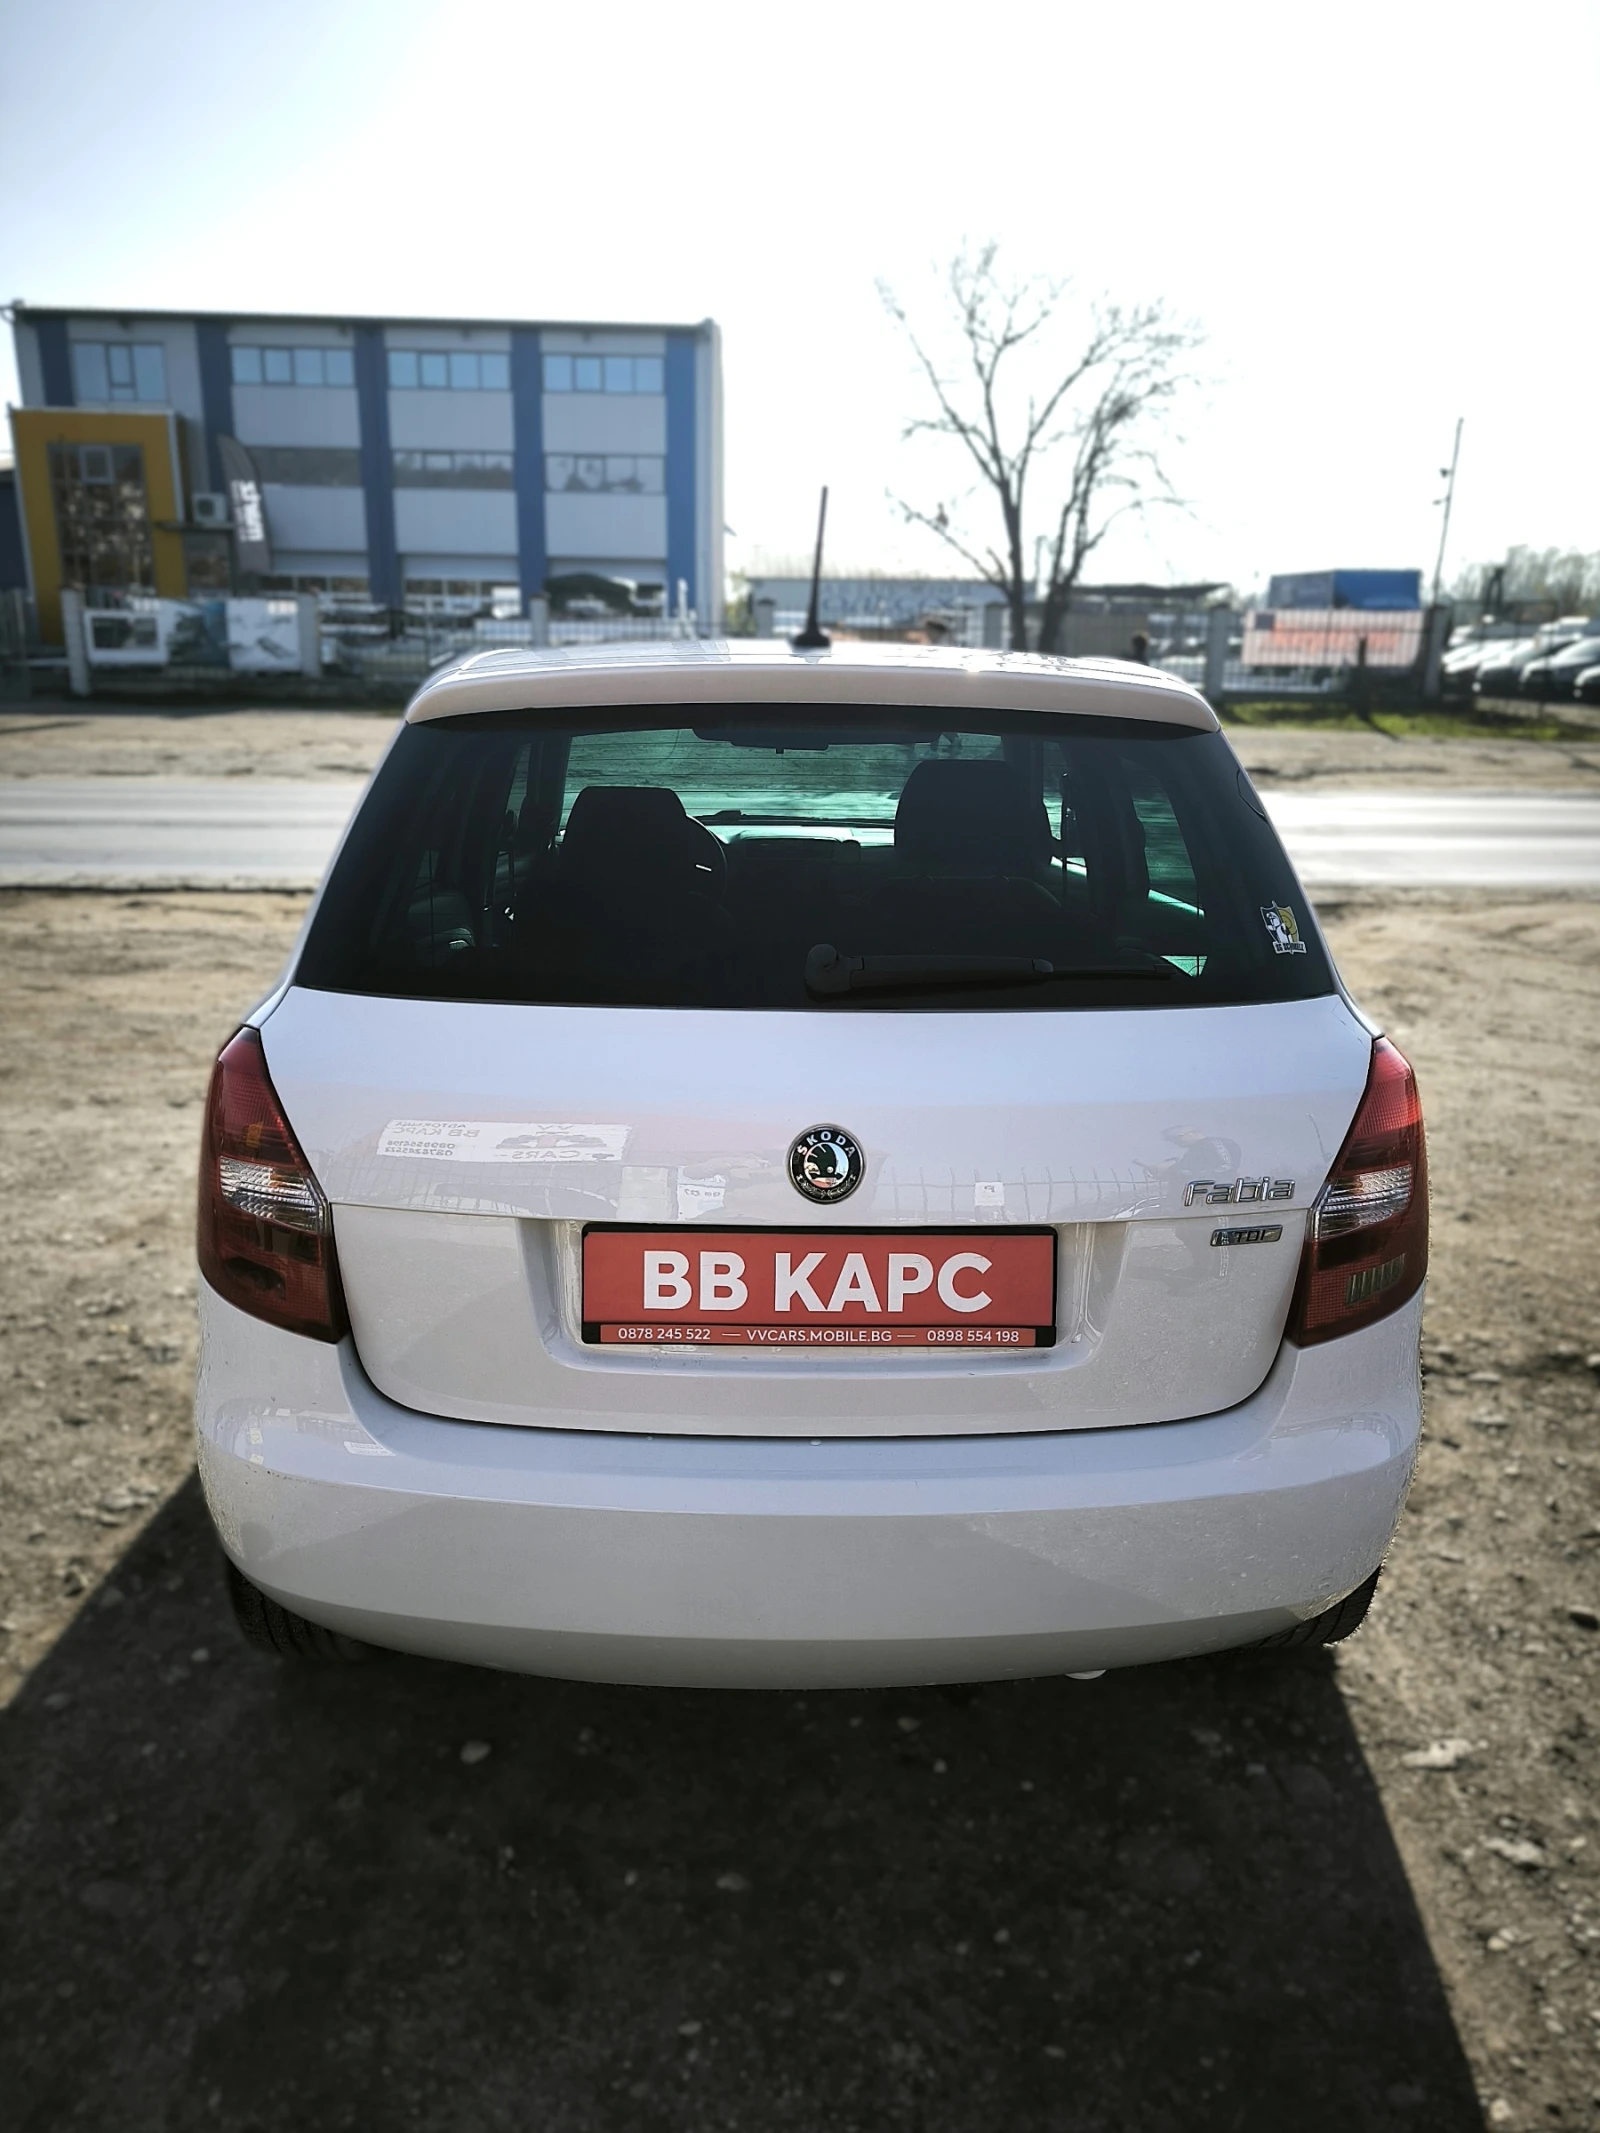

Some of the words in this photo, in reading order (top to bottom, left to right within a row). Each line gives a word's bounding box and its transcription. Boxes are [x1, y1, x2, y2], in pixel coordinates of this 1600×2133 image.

[1184, 1176, 1296, 1207] Fabia
[643, 1250, 749, 1311] ВВ
[774, 1252, 993, 1313] КАРС
[618, 1328, 653, 1340] 0878
[656, 1328, 683, 1340] 245
[685, 1328, 711, 1340] 522
[746, 1329, 892, 1342] VVCARS.MOBILE.BG
[926, 1330, 964, 1342] 0898
[966, 1330, 992, 1342] 554
[995, 1330, 1020, 1343] 198
